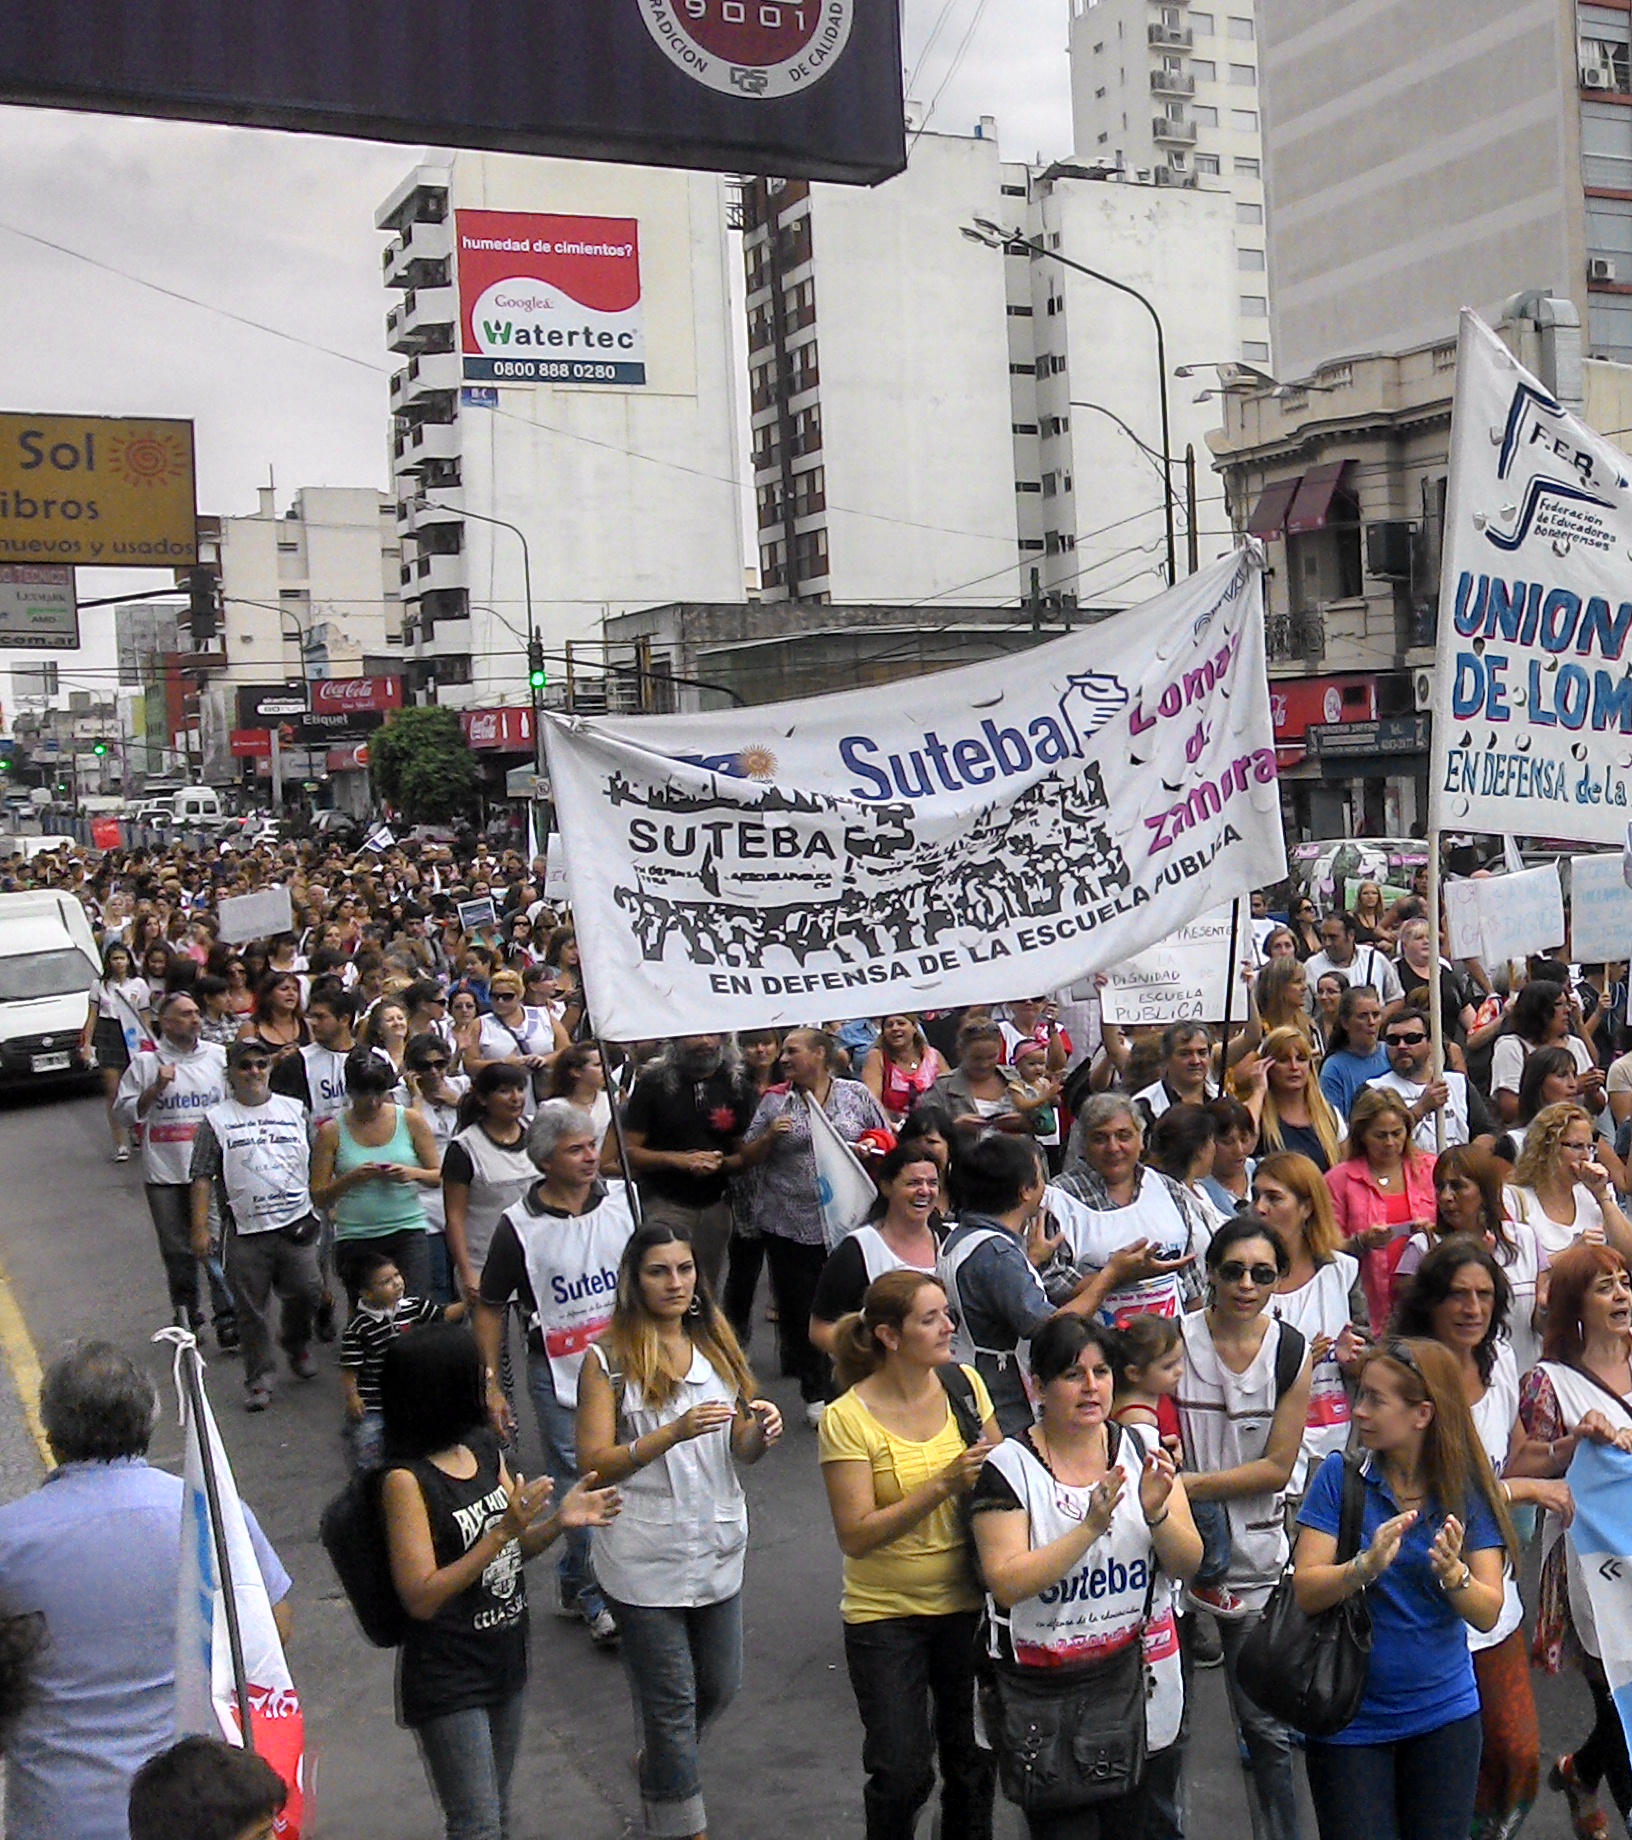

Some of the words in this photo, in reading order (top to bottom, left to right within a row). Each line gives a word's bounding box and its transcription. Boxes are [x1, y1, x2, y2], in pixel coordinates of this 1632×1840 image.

[789, 62, 809, 82] DE
[808, 3, 843, 66] CALIDAD
[462, 236, 530, 252] humedad
[533, 239, 551, 253] de
[554, 241, 633, 257] cimientos?
[483, 319, 634, 349] Watertec
[493, 361, 535, 376] 0800
[538, 363, 569, 378] 888
[573, 364, 616, 379] 0280
[18, 430, 95, 471] Sol
[90, 542, 104, 556] y
[112, 538, 194, 555] usados
[1536, 512, 1549, 524] de
[1551, 515, 1617, 542] Educadores
[1129, 632, 1240, 736] Loma
[1453, 652, 1510, 722] DE
[838, 716, 1073, 801] Suteba
[1444, 749, 1477, 797] EN
[1481, 752, 1570, 803] DEFENSA
[1575, 763, 1600, 804] de
[1605, 765, 1628, 806] la
[628, 818, 838, 861] SUTEBA
[709, 972, 752, 997] EN
[761, 960, 912, 997] DEFENSA
[920, 949, 962, 977] DE
[970, 937, 1012, 964] LA
[1016, 885, 1151, 954] ESCUELA
[1138, 988, 1204, 1004] ESCUELA
[551, 1265, 620, 1304] Suteb
